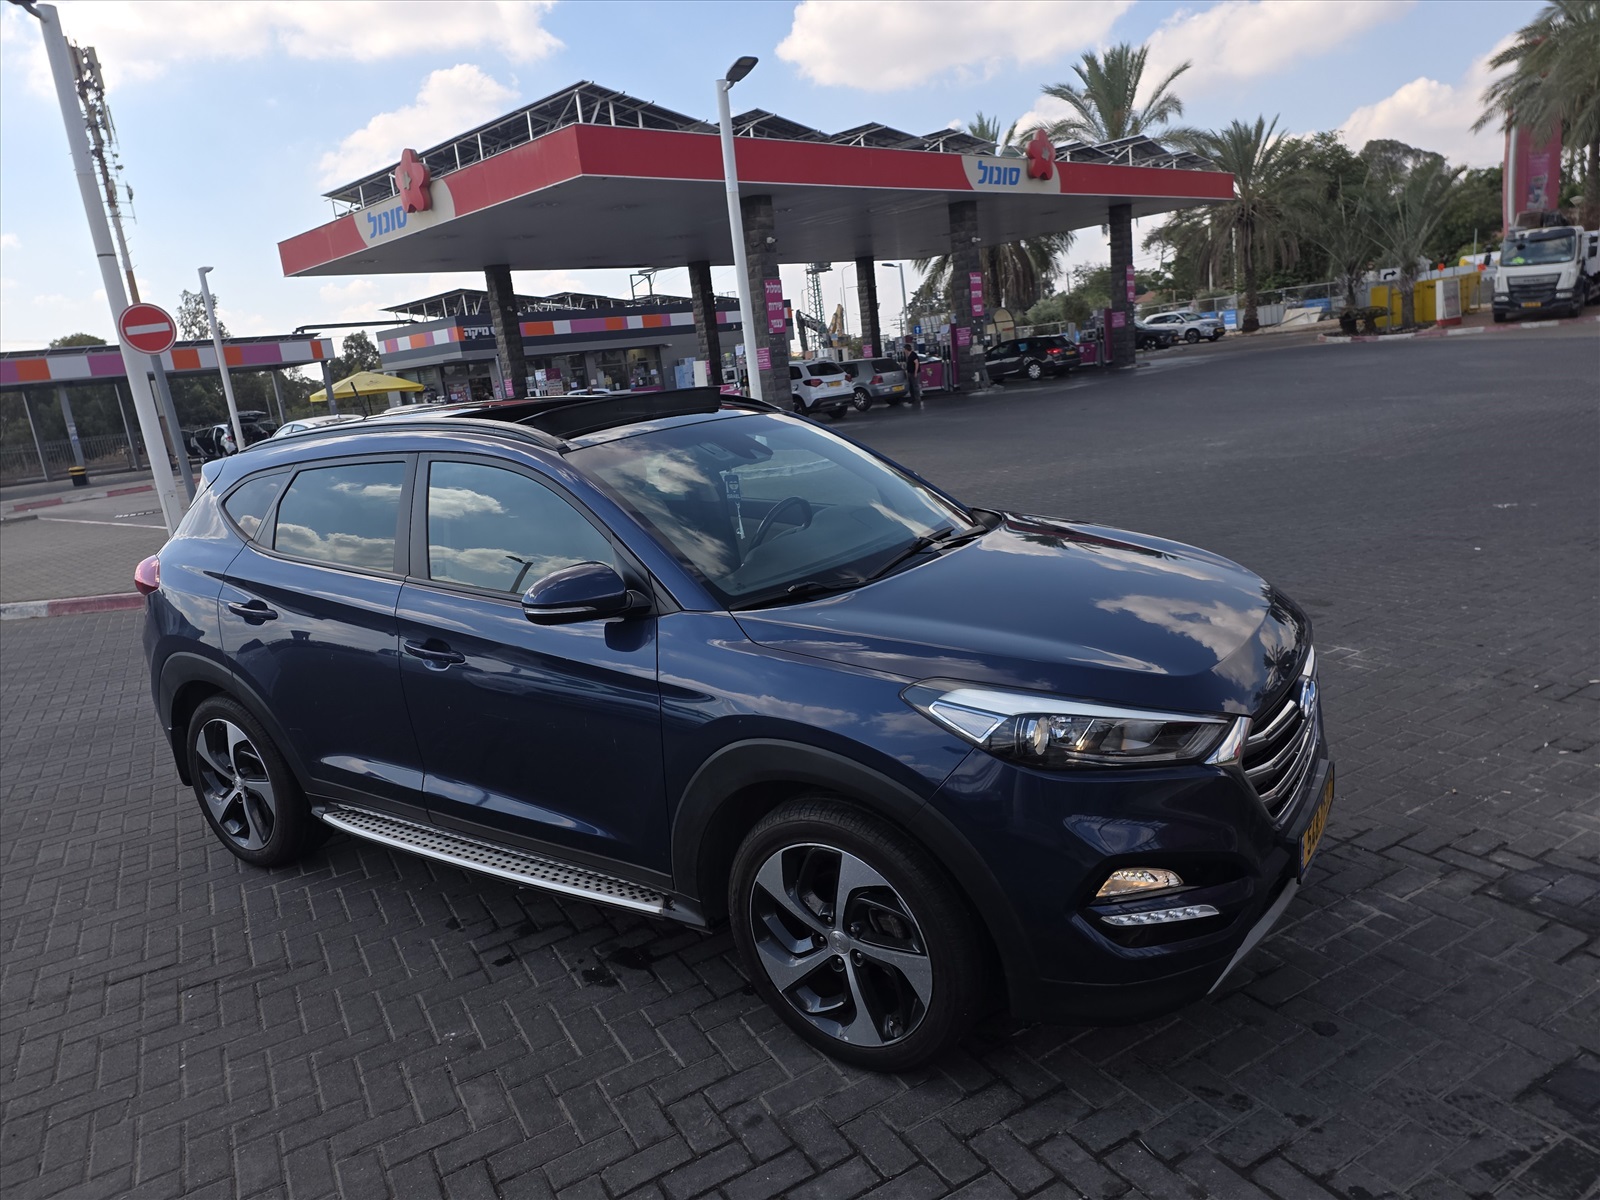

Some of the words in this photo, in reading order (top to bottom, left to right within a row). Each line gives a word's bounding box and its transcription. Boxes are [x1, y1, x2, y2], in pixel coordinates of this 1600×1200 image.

[977, 160, 1021, 186] סונול
[367, 205, 407, 239] סונול
[463, 326, 490, 339] מיקה
